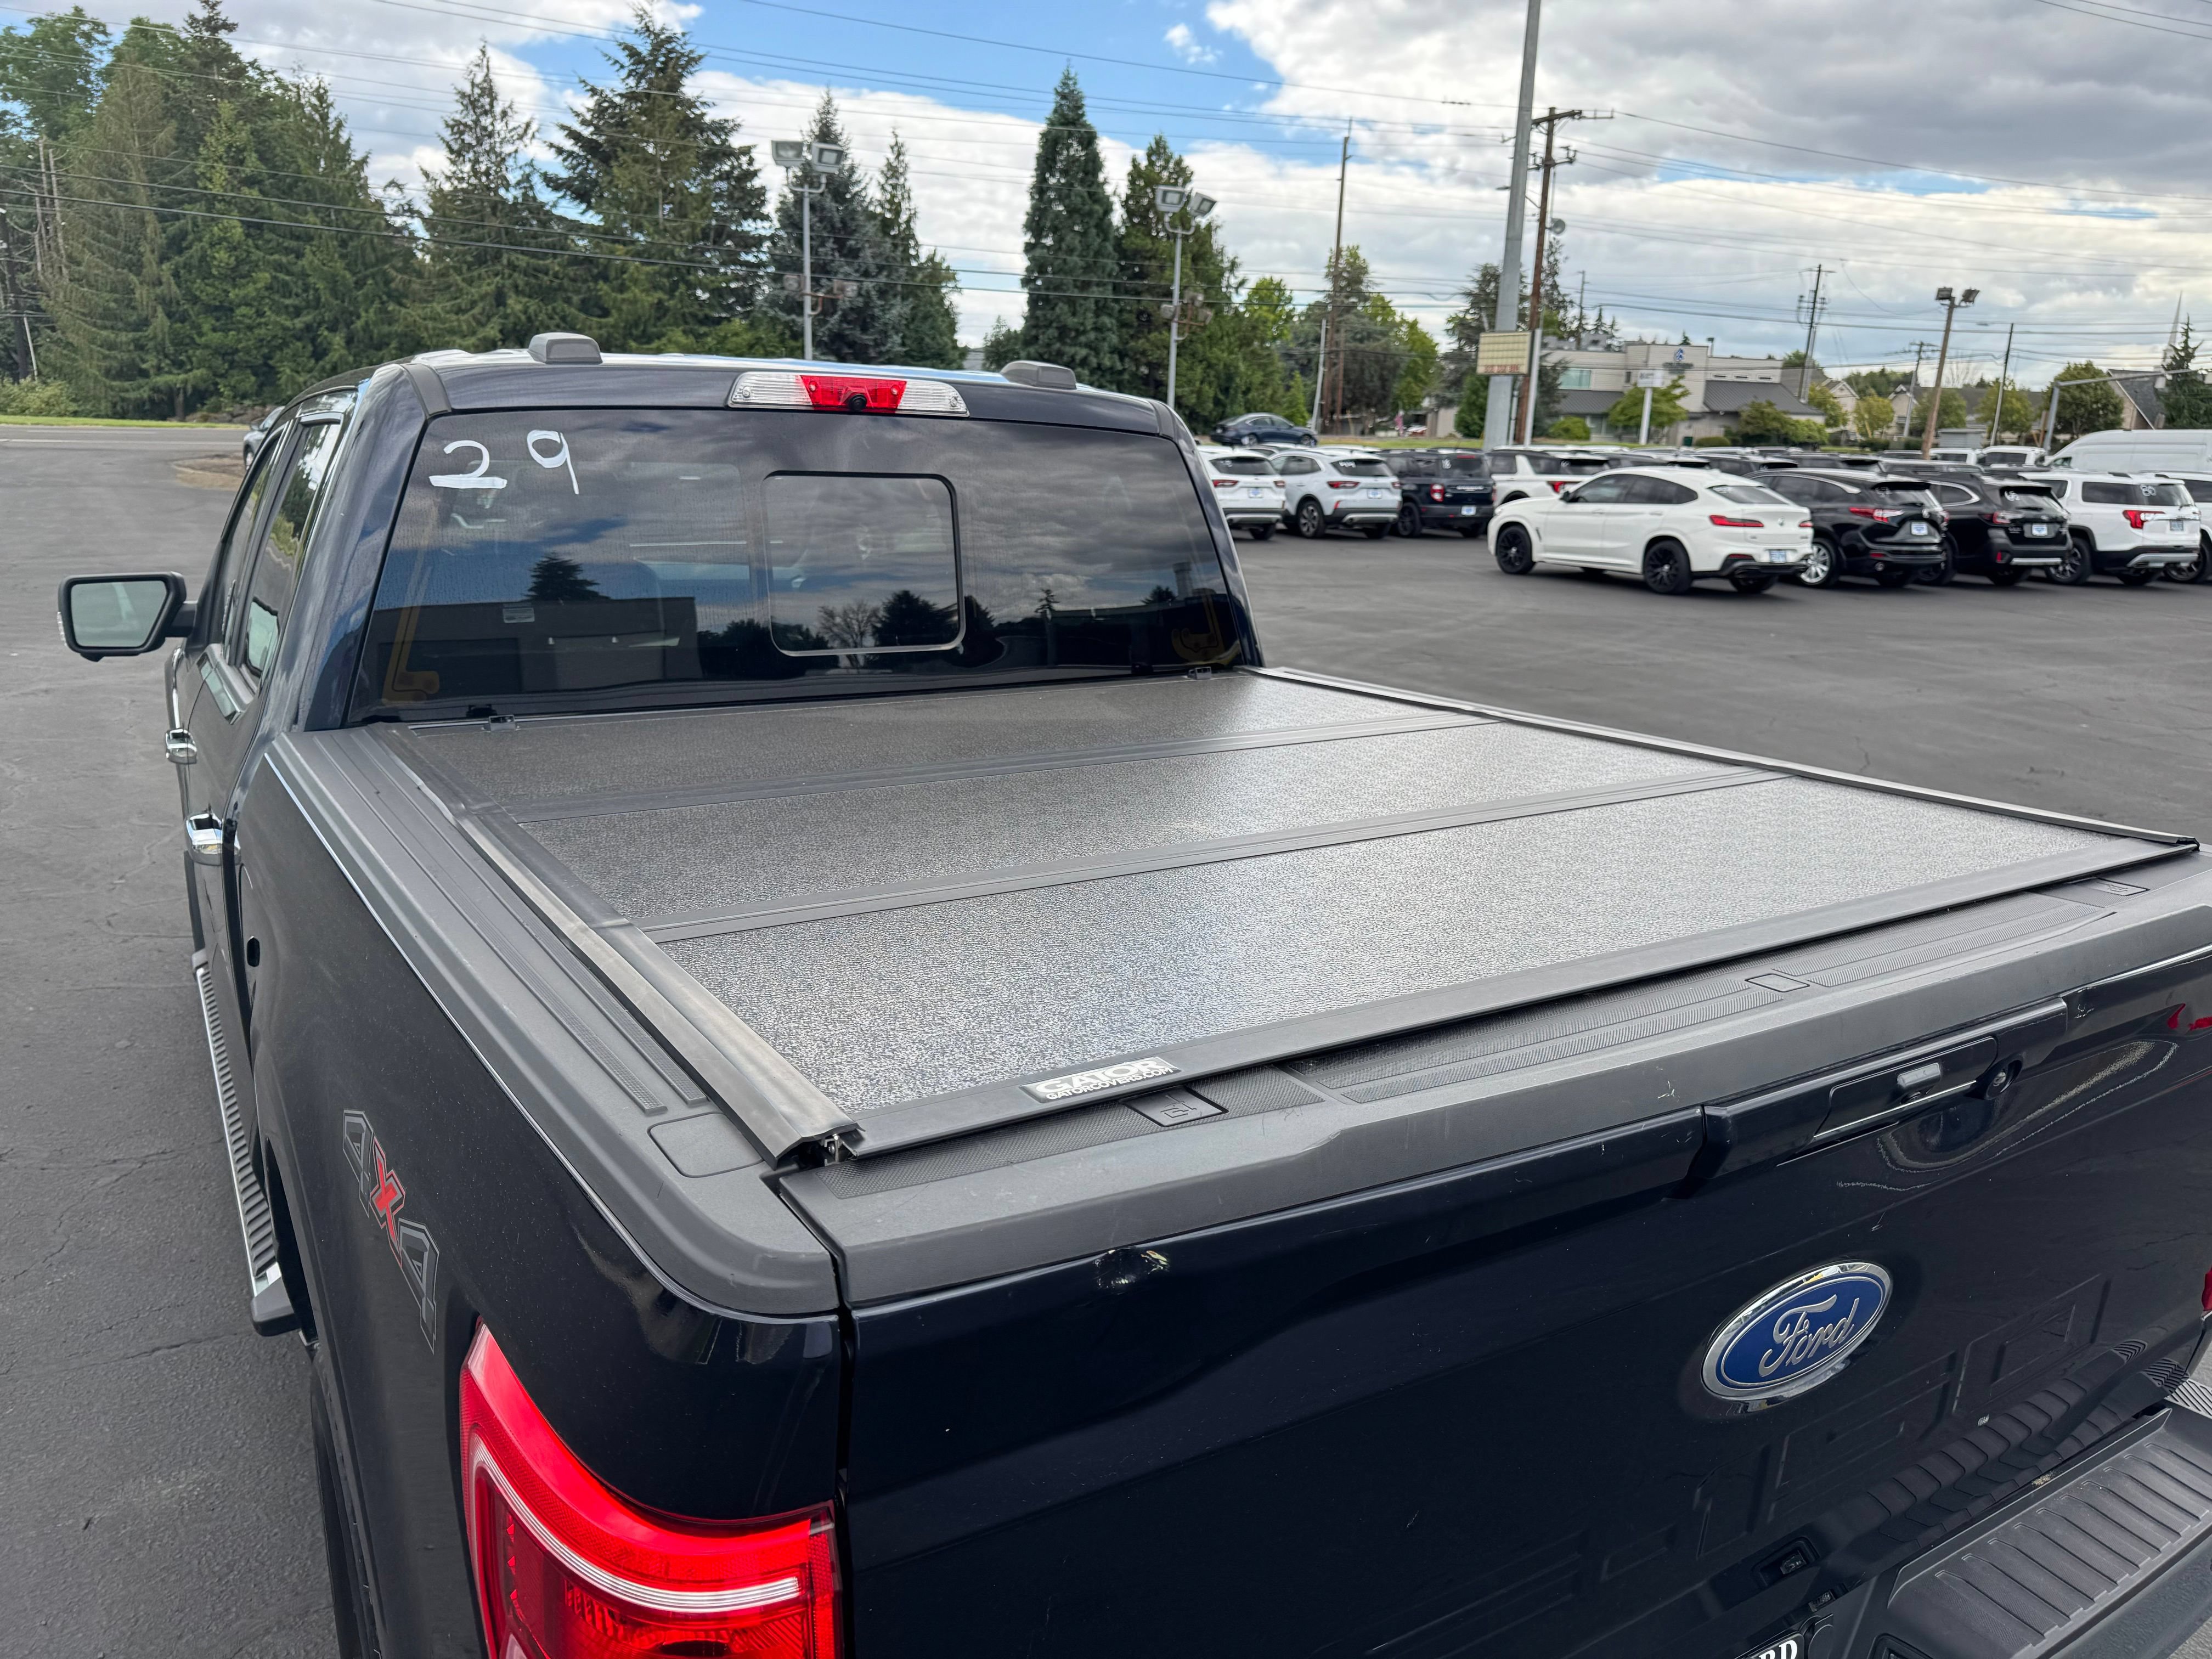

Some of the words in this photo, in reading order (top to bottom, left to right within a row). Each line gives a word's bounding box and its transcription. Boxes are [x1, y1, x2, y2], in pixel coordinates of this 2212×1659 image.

[428, 429, 579, 495] 29
[1035, 1059, 1166, 1093] GATOR
[1046, 1066, 1173, 1100] GATORCOVERS.COM
[1758, 1291, 1860, 1378] Ford
